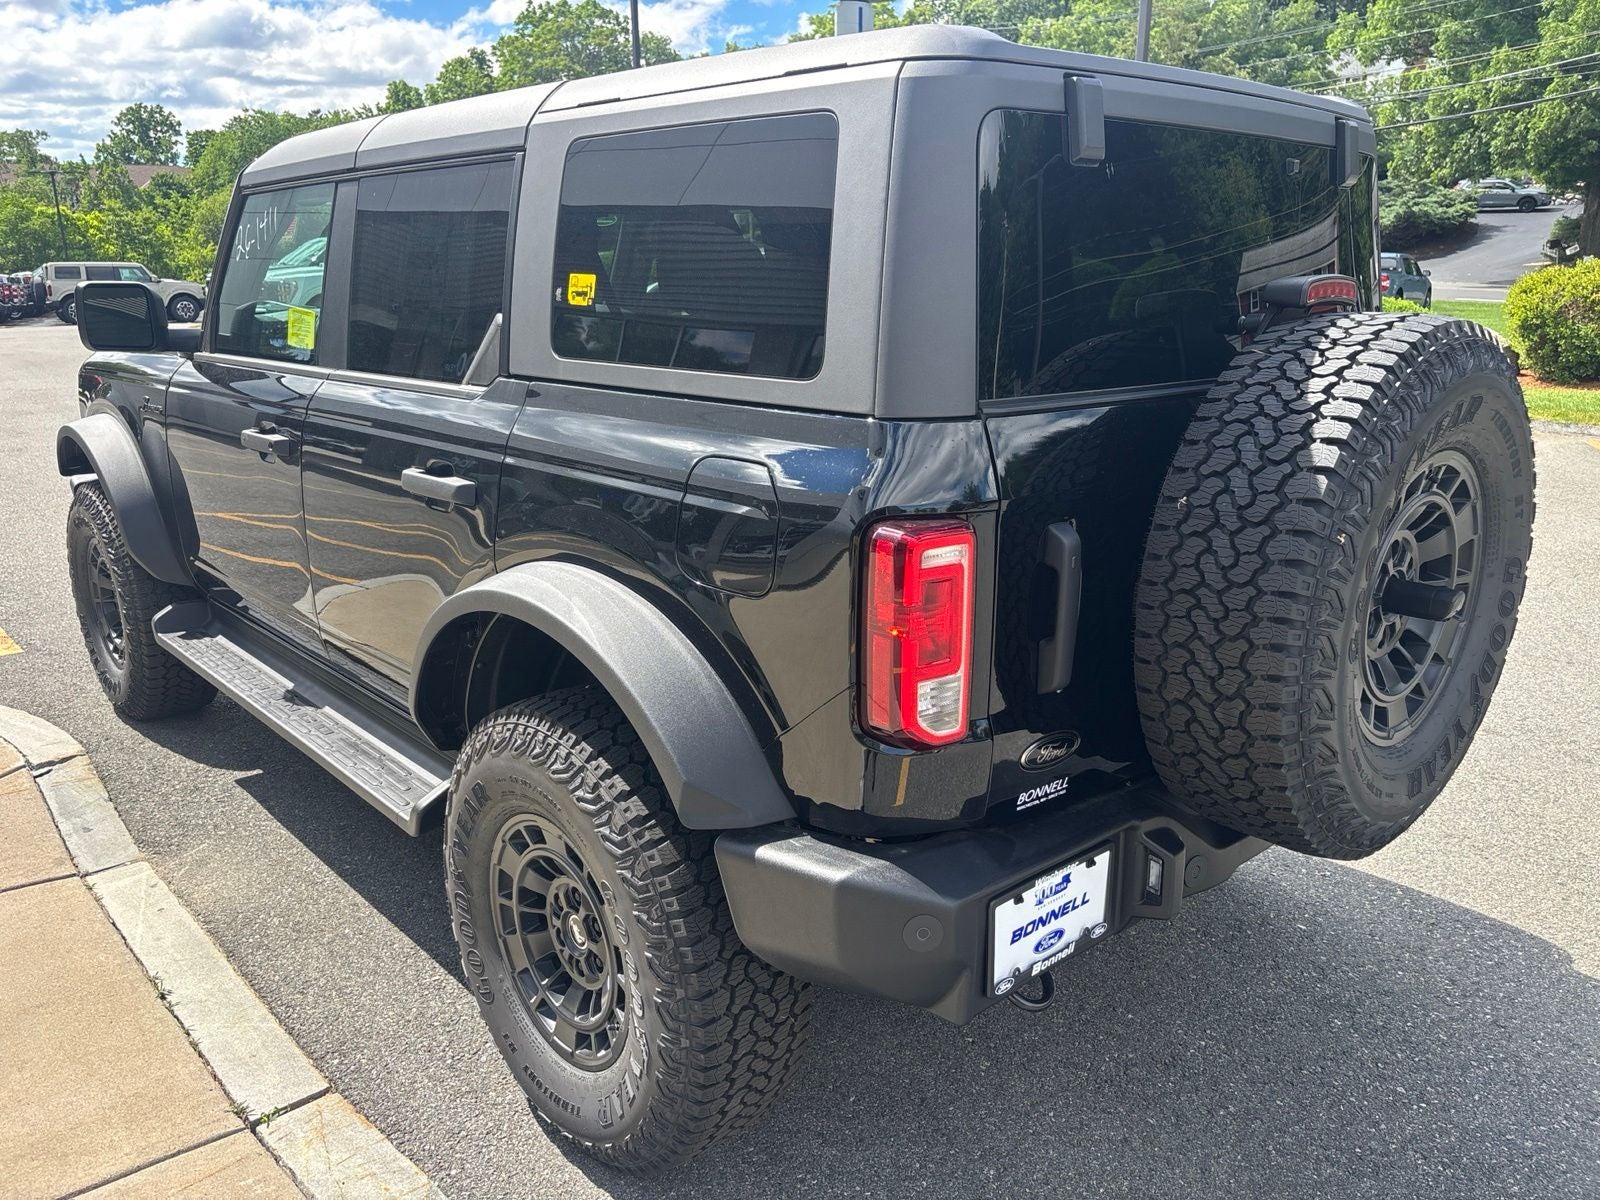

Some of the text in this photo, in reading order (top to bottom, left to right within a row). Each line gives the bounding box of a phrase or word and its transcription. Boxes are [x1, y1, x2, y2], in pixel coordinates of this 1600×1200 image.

[1016, 776, 1069, 806] BONNELL
[1010, 891, 1090, 946] BONNELL
[1031, 942, 1076, 977] Bonnell
[522, 1064, 582, 1119] TERRITORY
